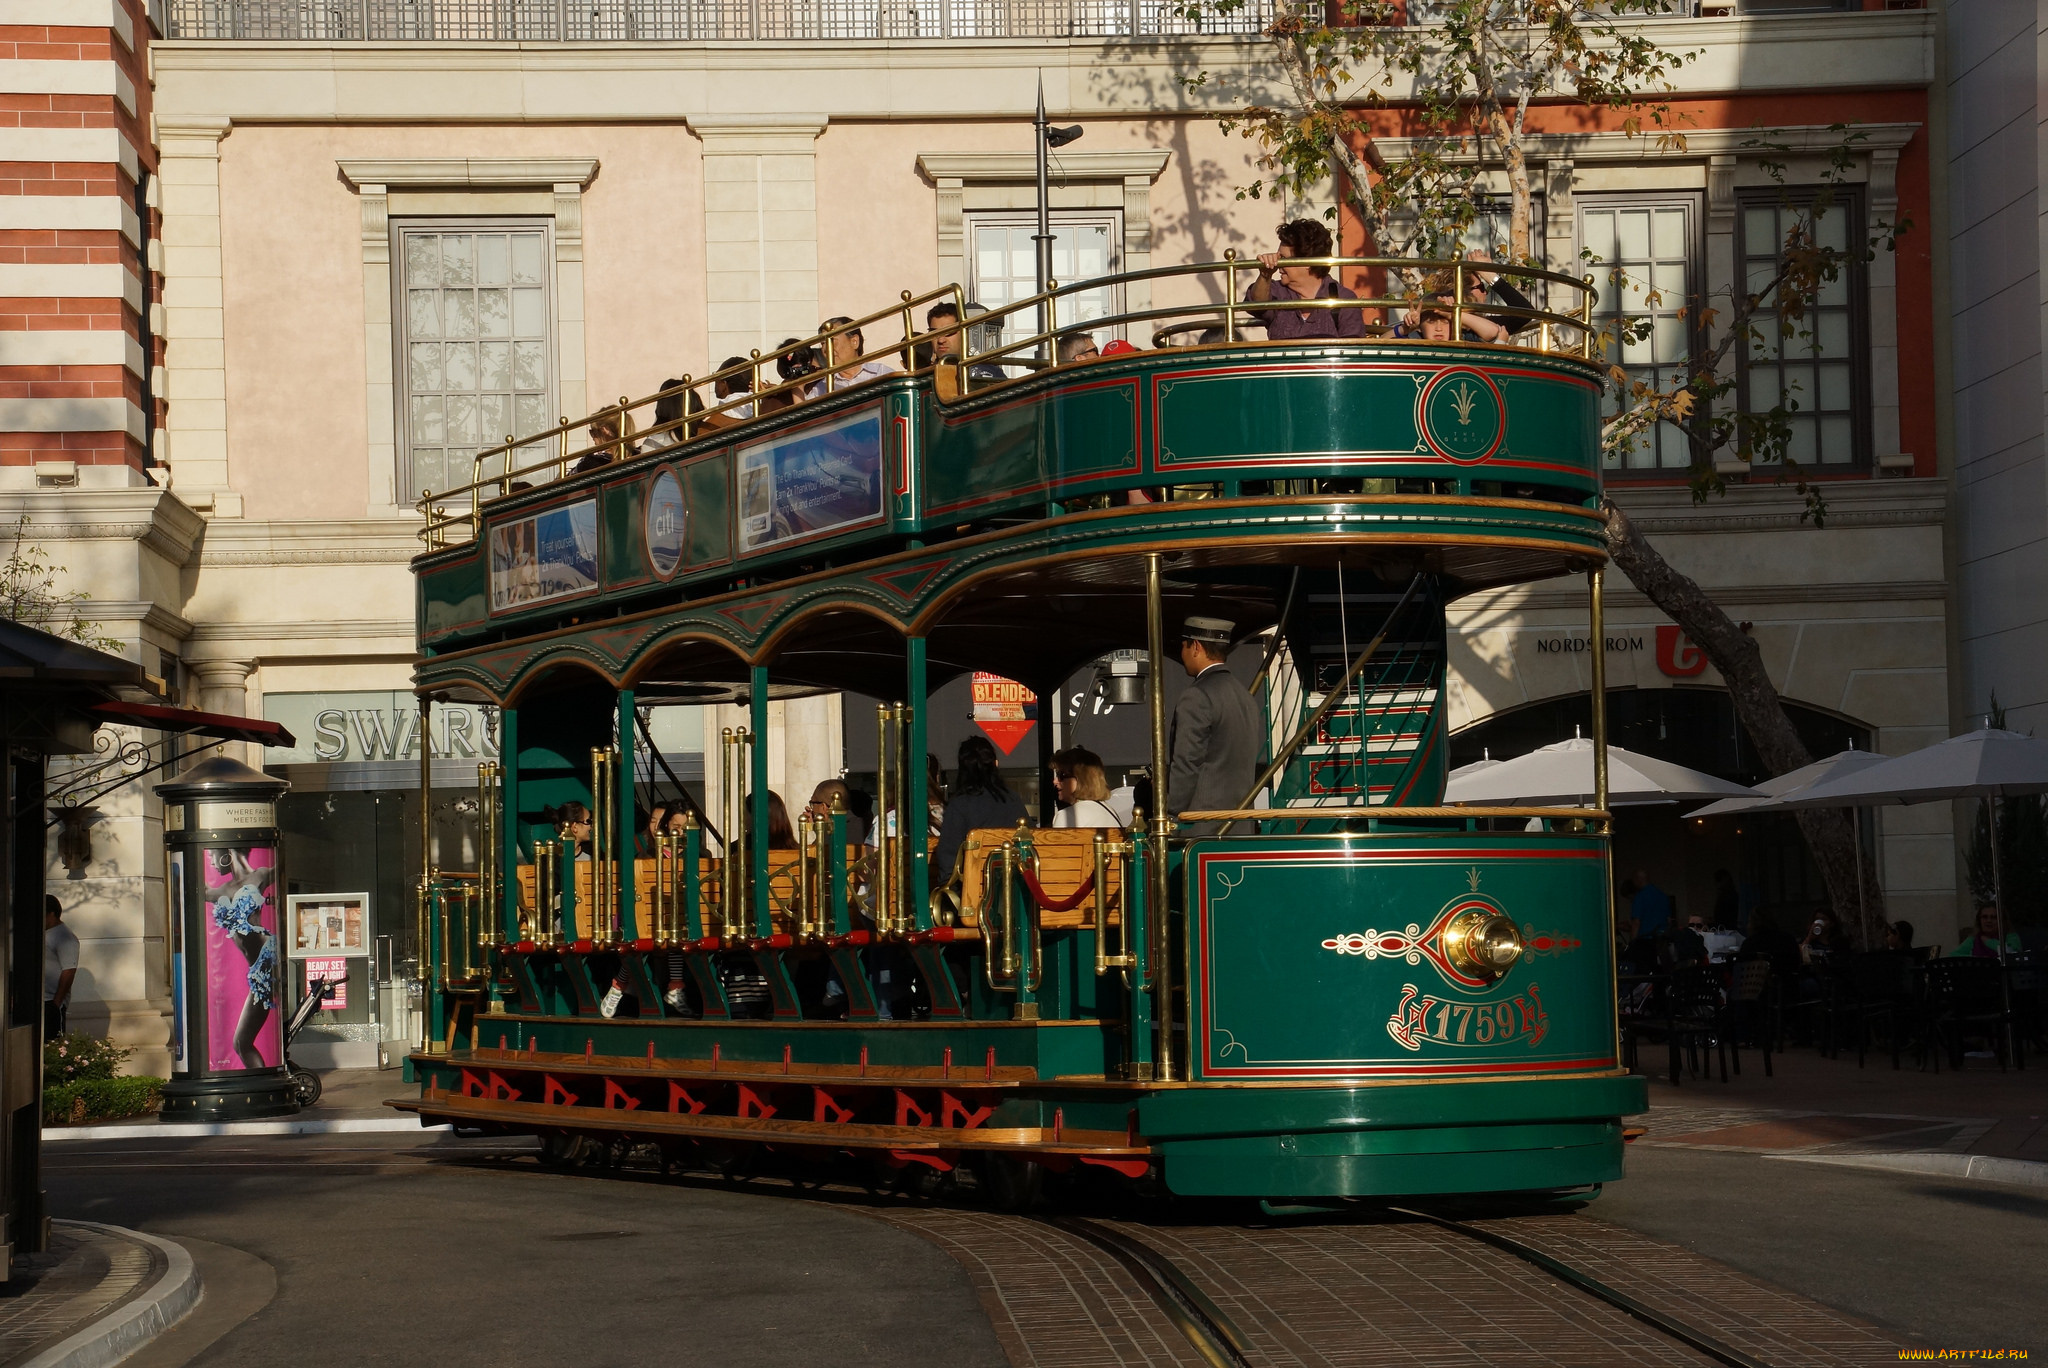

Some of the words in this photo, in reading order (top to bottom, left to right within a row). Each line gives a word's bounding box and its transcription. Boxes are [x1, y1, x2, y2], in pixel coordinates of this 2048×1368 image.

[1537, 637, 1644, 653] NORDSROM
[974, 683, 1034, 702] BLENDED
[307, 971, 319, 980] GET
[1432, 1003, 1515, 1043] 1759
